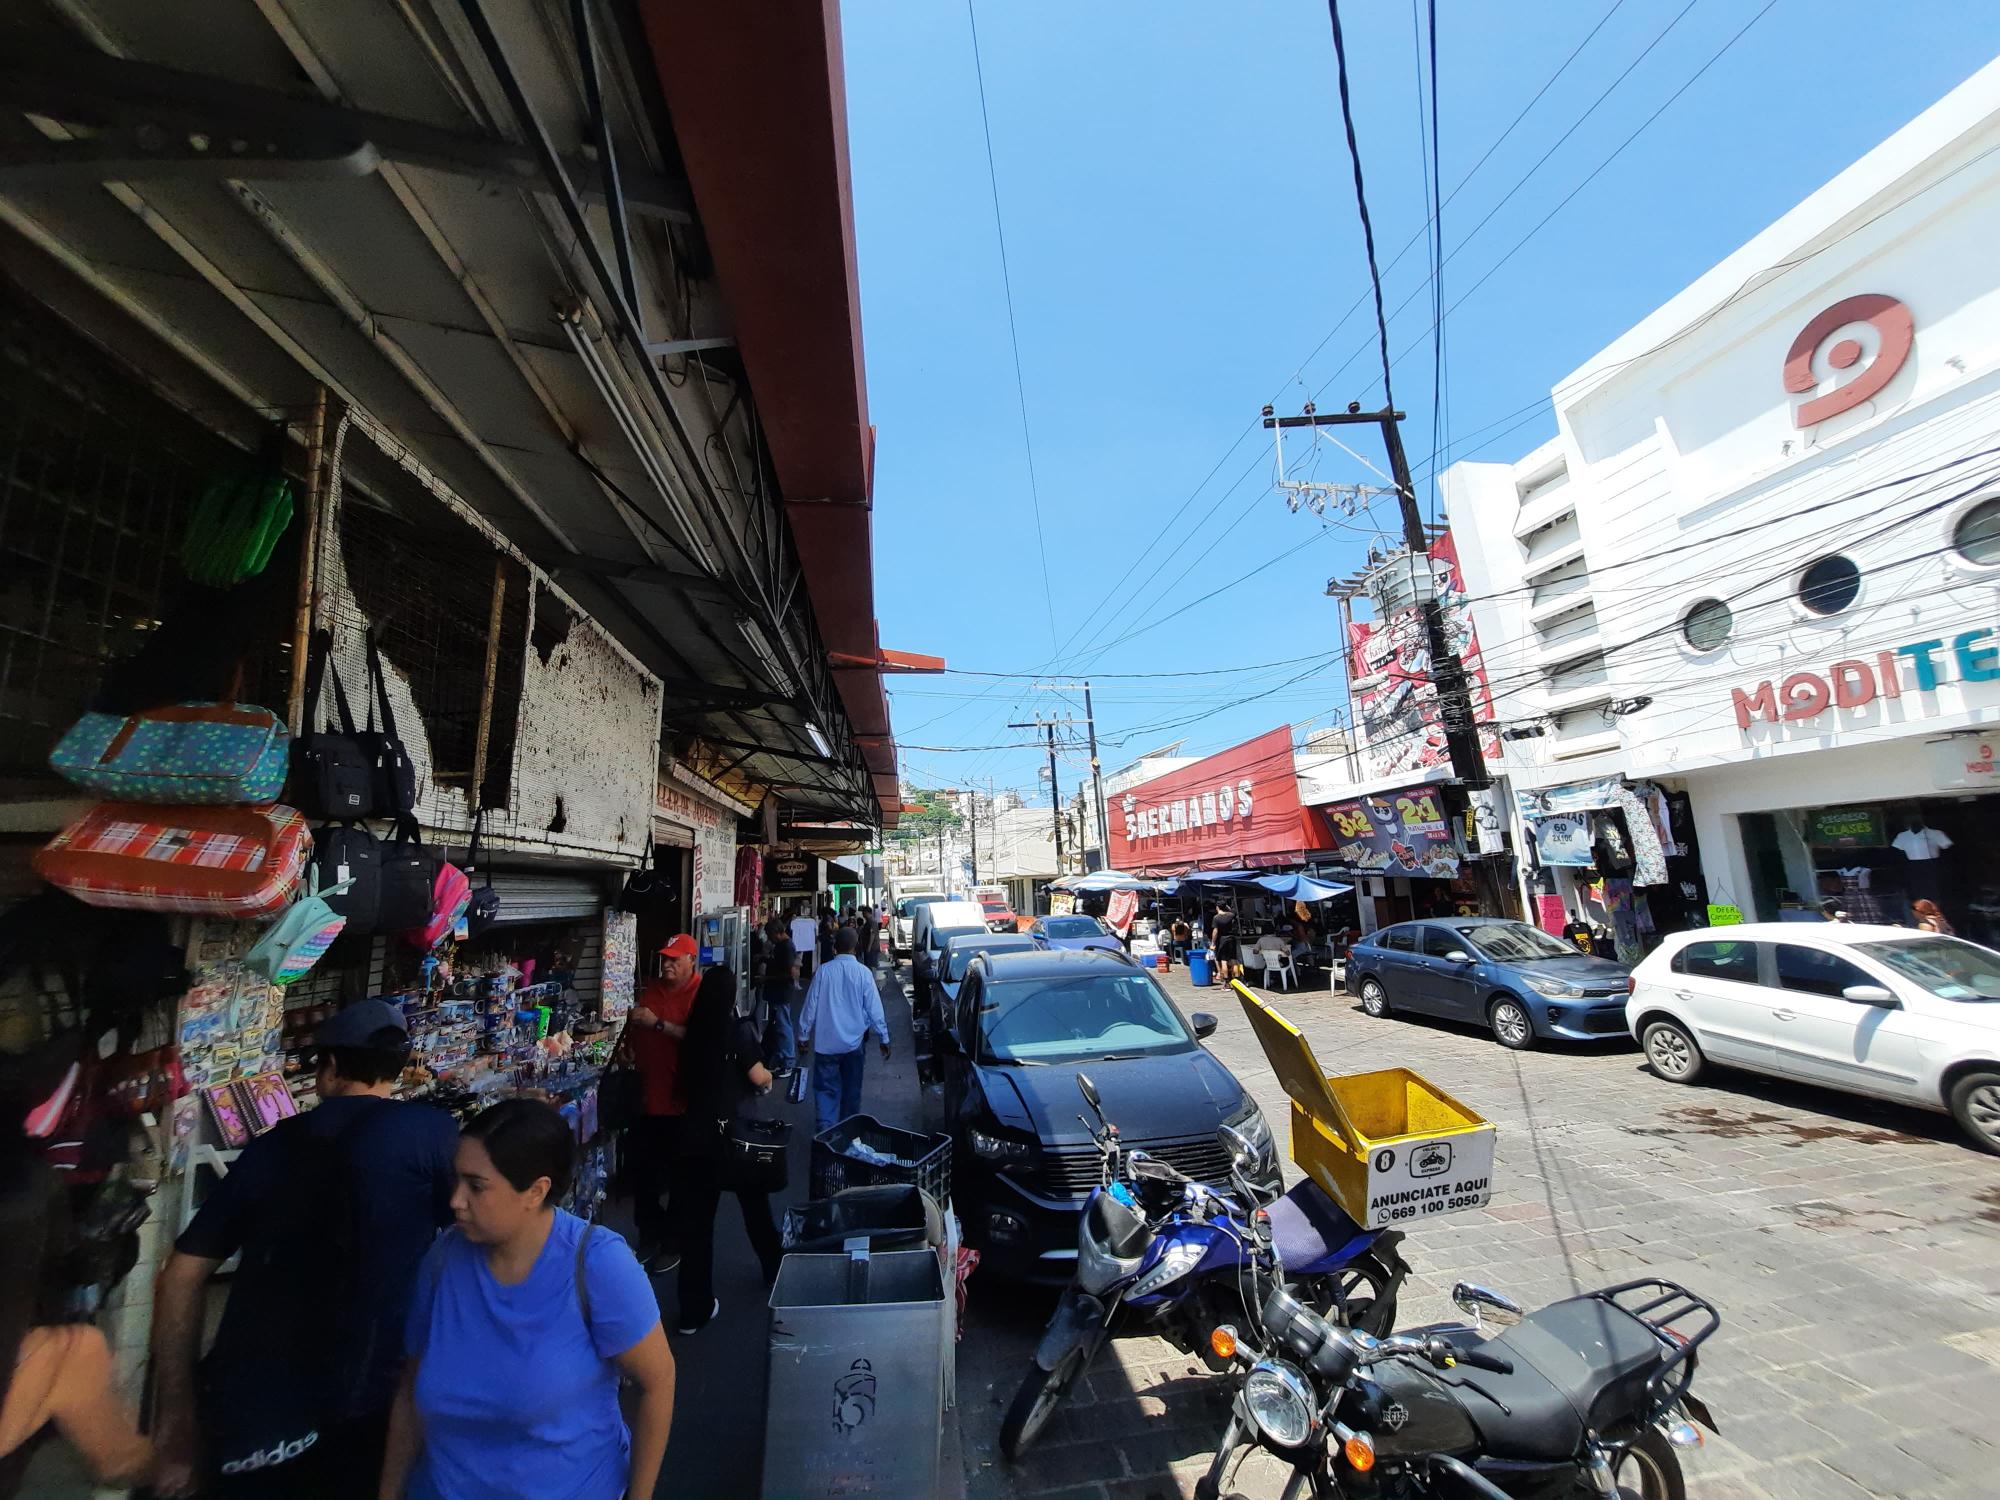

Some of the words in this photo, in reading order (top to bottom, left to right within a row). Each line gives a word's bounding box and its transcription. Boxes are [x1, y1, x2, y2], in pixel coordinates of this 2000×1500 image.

[1823, 821, 1872, 835] CLASES
[1371, 1184, 1450, 1209] ANUNCIATE
[1455, 1178, 1487, 1193] AQUI
[1392, 1206, 1415, 1220] 669
[1421, 1200, 1443, 1214] 100
[1448, 1194, 1479, 1209] 5050
[221, 1430, 318, 1474] adidas
